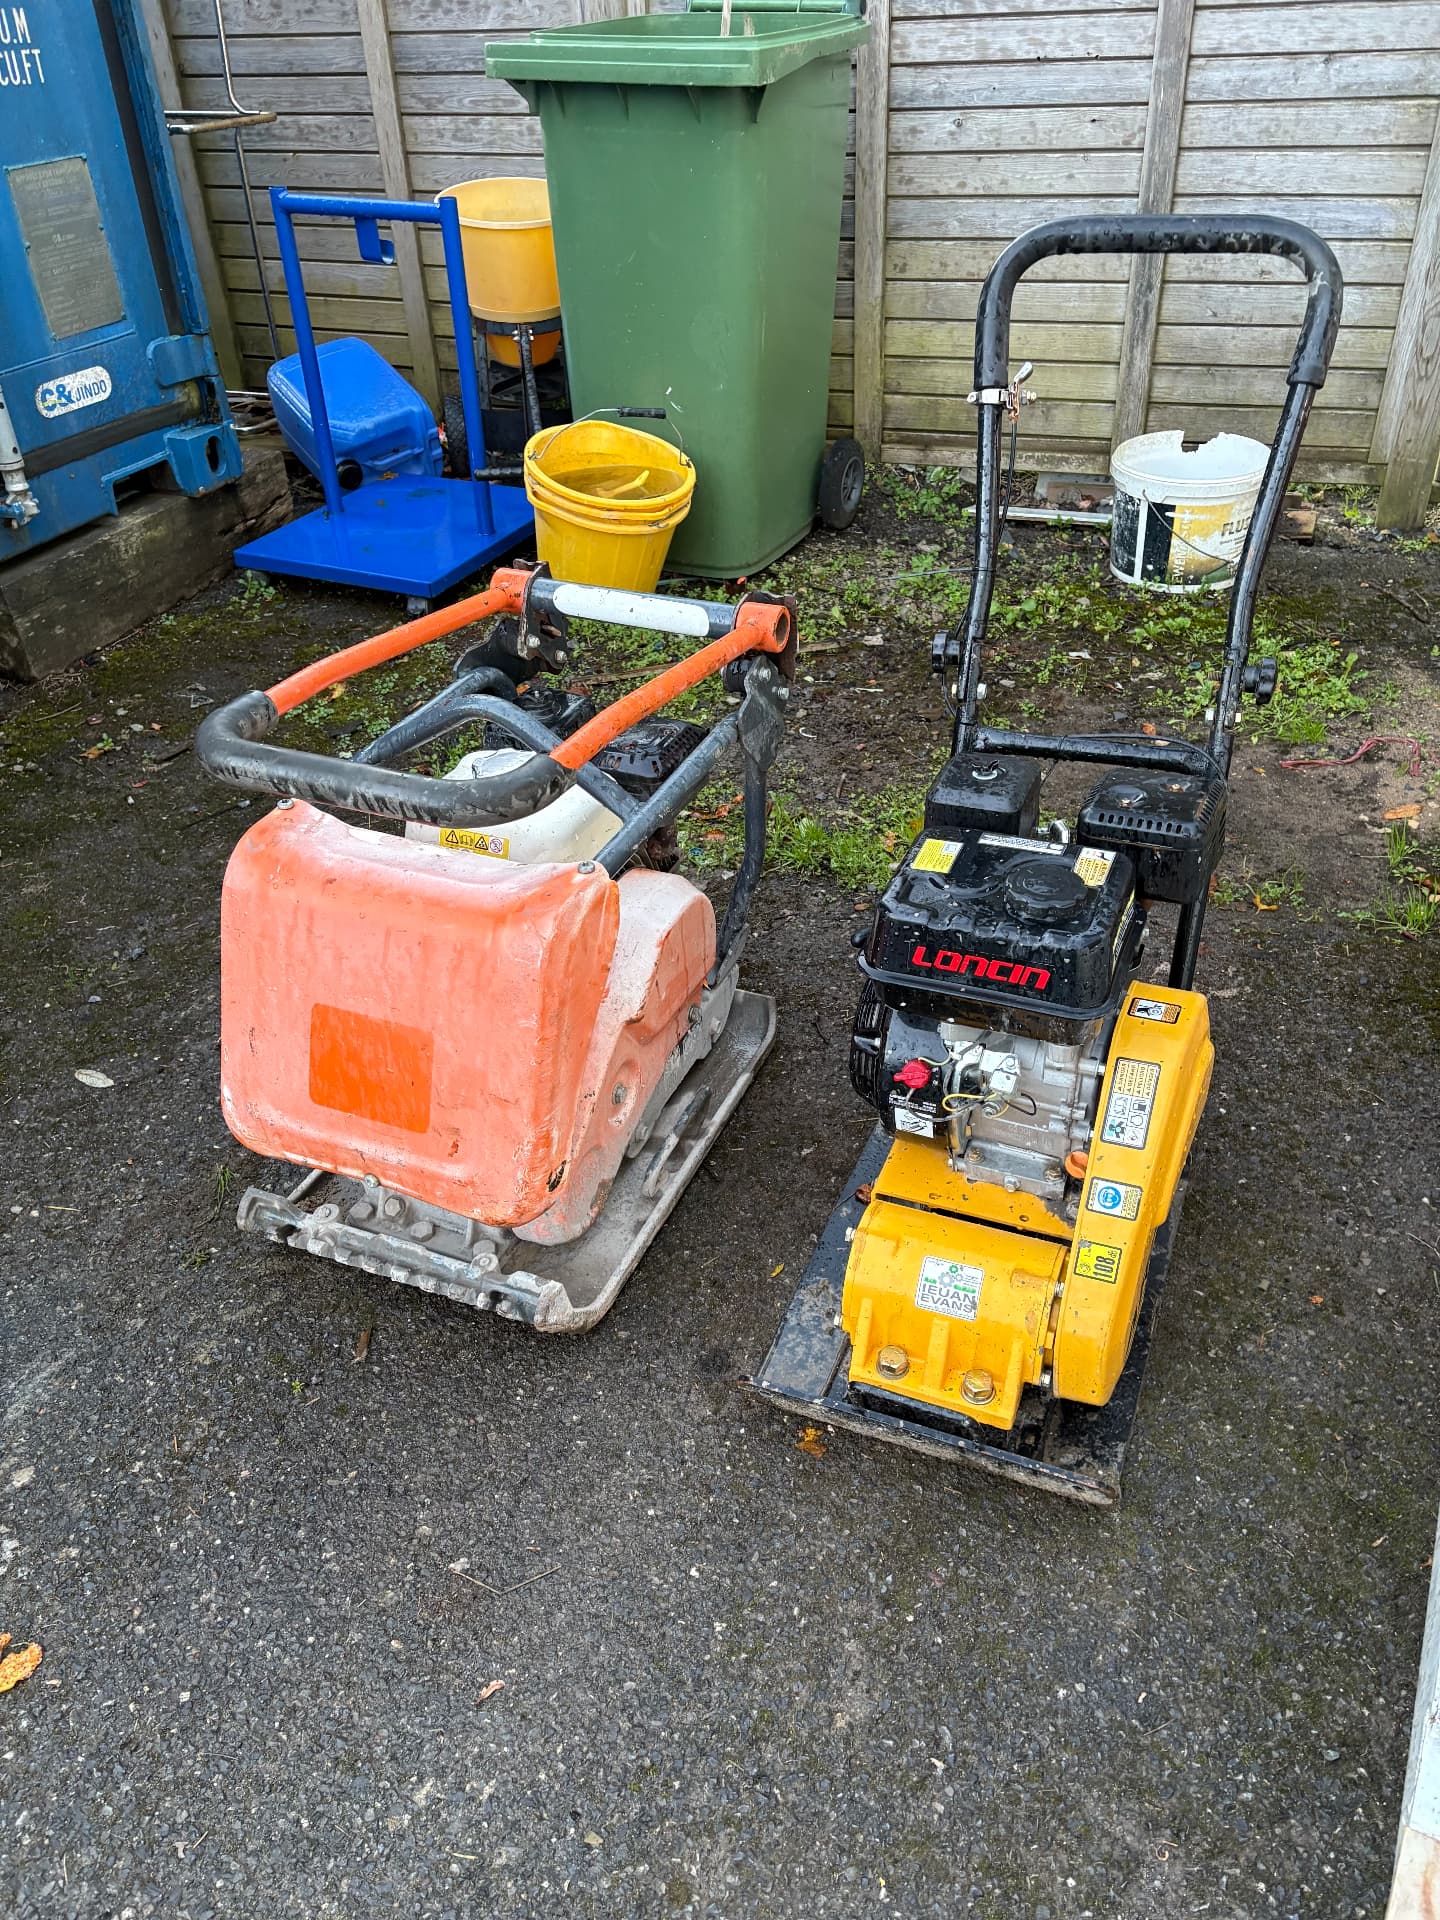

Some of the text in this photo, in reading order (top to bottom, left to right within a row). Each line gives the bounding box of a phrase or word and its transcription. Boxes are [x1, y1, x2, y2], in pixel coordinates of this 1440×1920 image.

[75, 379, 108, 402] JINDO
[1093, 1255, 1116, 1279] 108
[920, 1292, 974, 1314] EVANS
[921, 1283, 977, 1306] IEUAN
